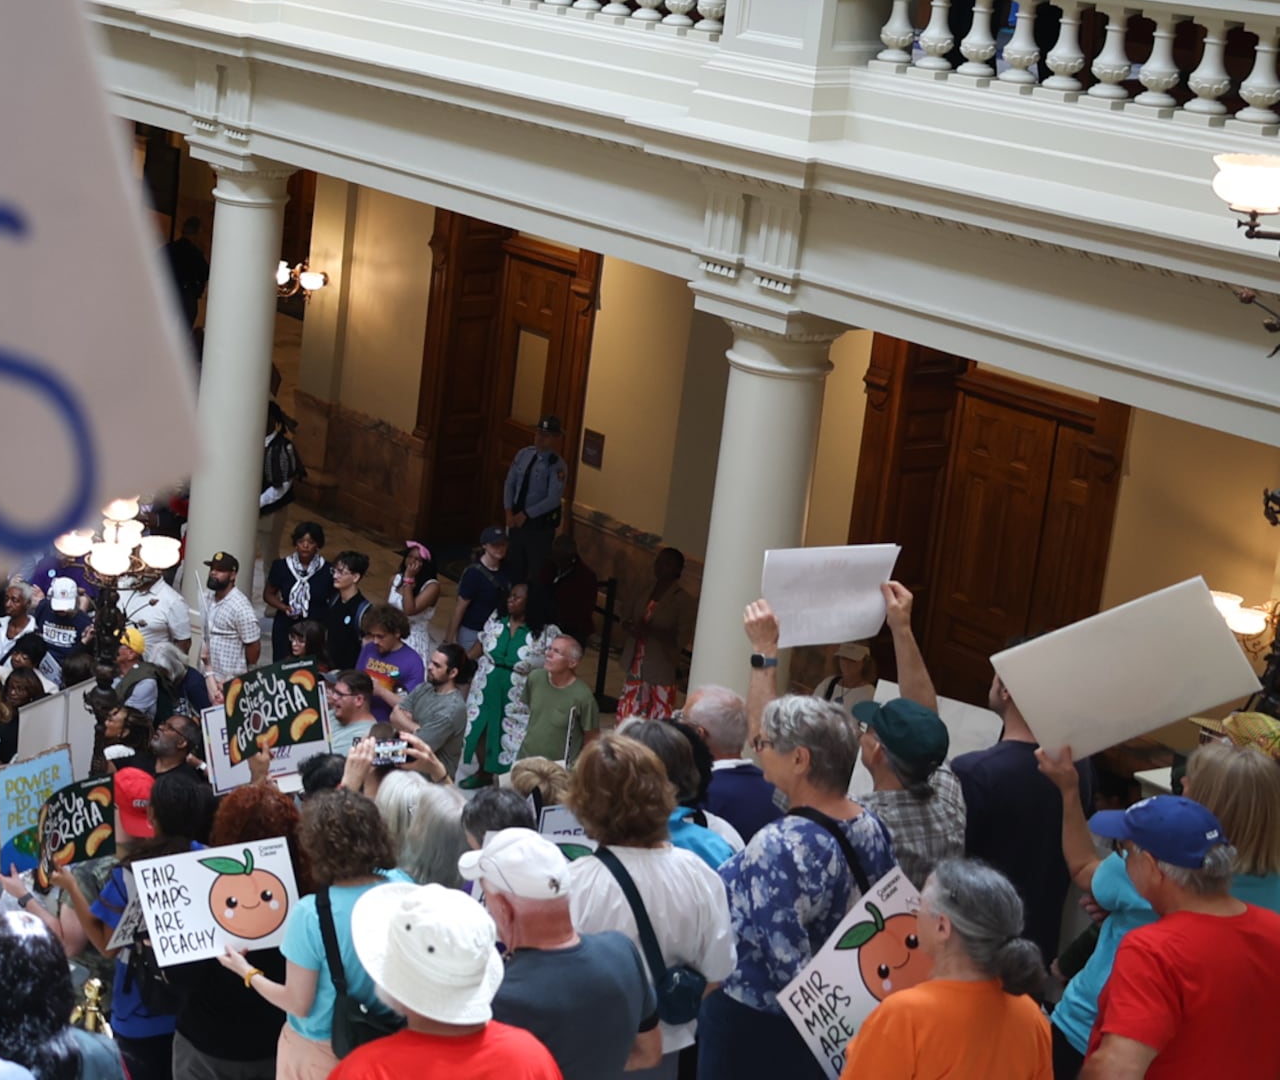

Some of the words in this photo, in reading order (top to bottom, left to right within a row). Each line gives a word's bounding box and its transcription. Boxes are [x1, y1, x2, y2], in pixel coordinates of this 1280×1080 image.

[237, 684, 309, 752] GEORGIA
[5, 764, 61, 801] POWER
[141, 863, 179, 889] FAIR
[146, 884, 192, 911] MAPS
[153, 910, 185, 935] ARE
[159, 926, 217, 957] PEACHY
[788, 970, 830, 1015] FAIR
[803, 985, 852, 1036] MAPS
[818, 1015, 855, 1058] ARE
